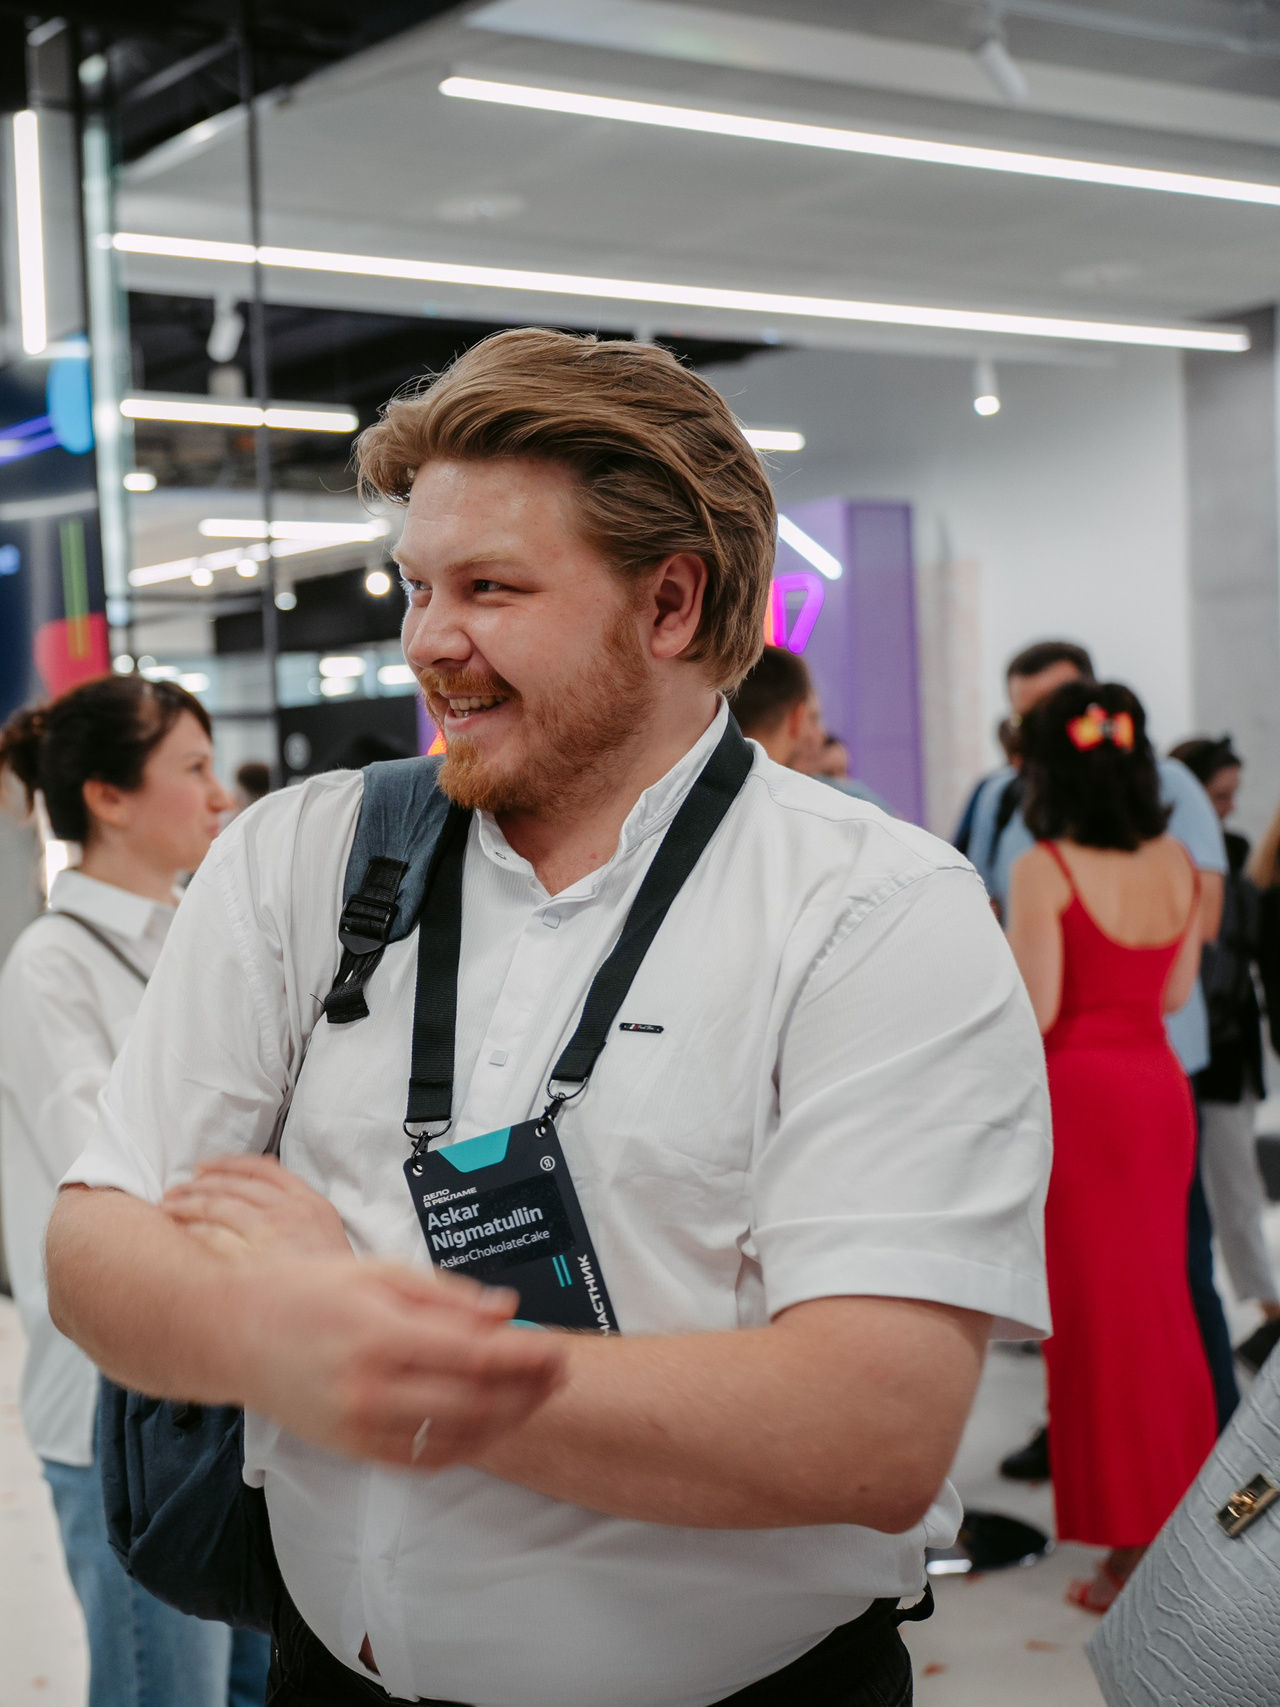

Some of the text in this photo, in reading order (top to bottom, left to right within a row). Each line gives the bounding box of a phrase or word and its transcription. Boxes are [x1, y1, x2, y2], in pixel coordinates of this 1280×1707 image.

[423, 1189, 450, 1202] ДЕЛО
[432, 1187, 477, 1205] РЕКЛАМЕ
[428, 1203, 480, 1231] Askar
[431, 1207, 544, 1251] Nigmatullin
[439, 1229, 551, 1269] AskarChokolateCake
[577, 1254, 610, 1337] ЧАСТНИК
